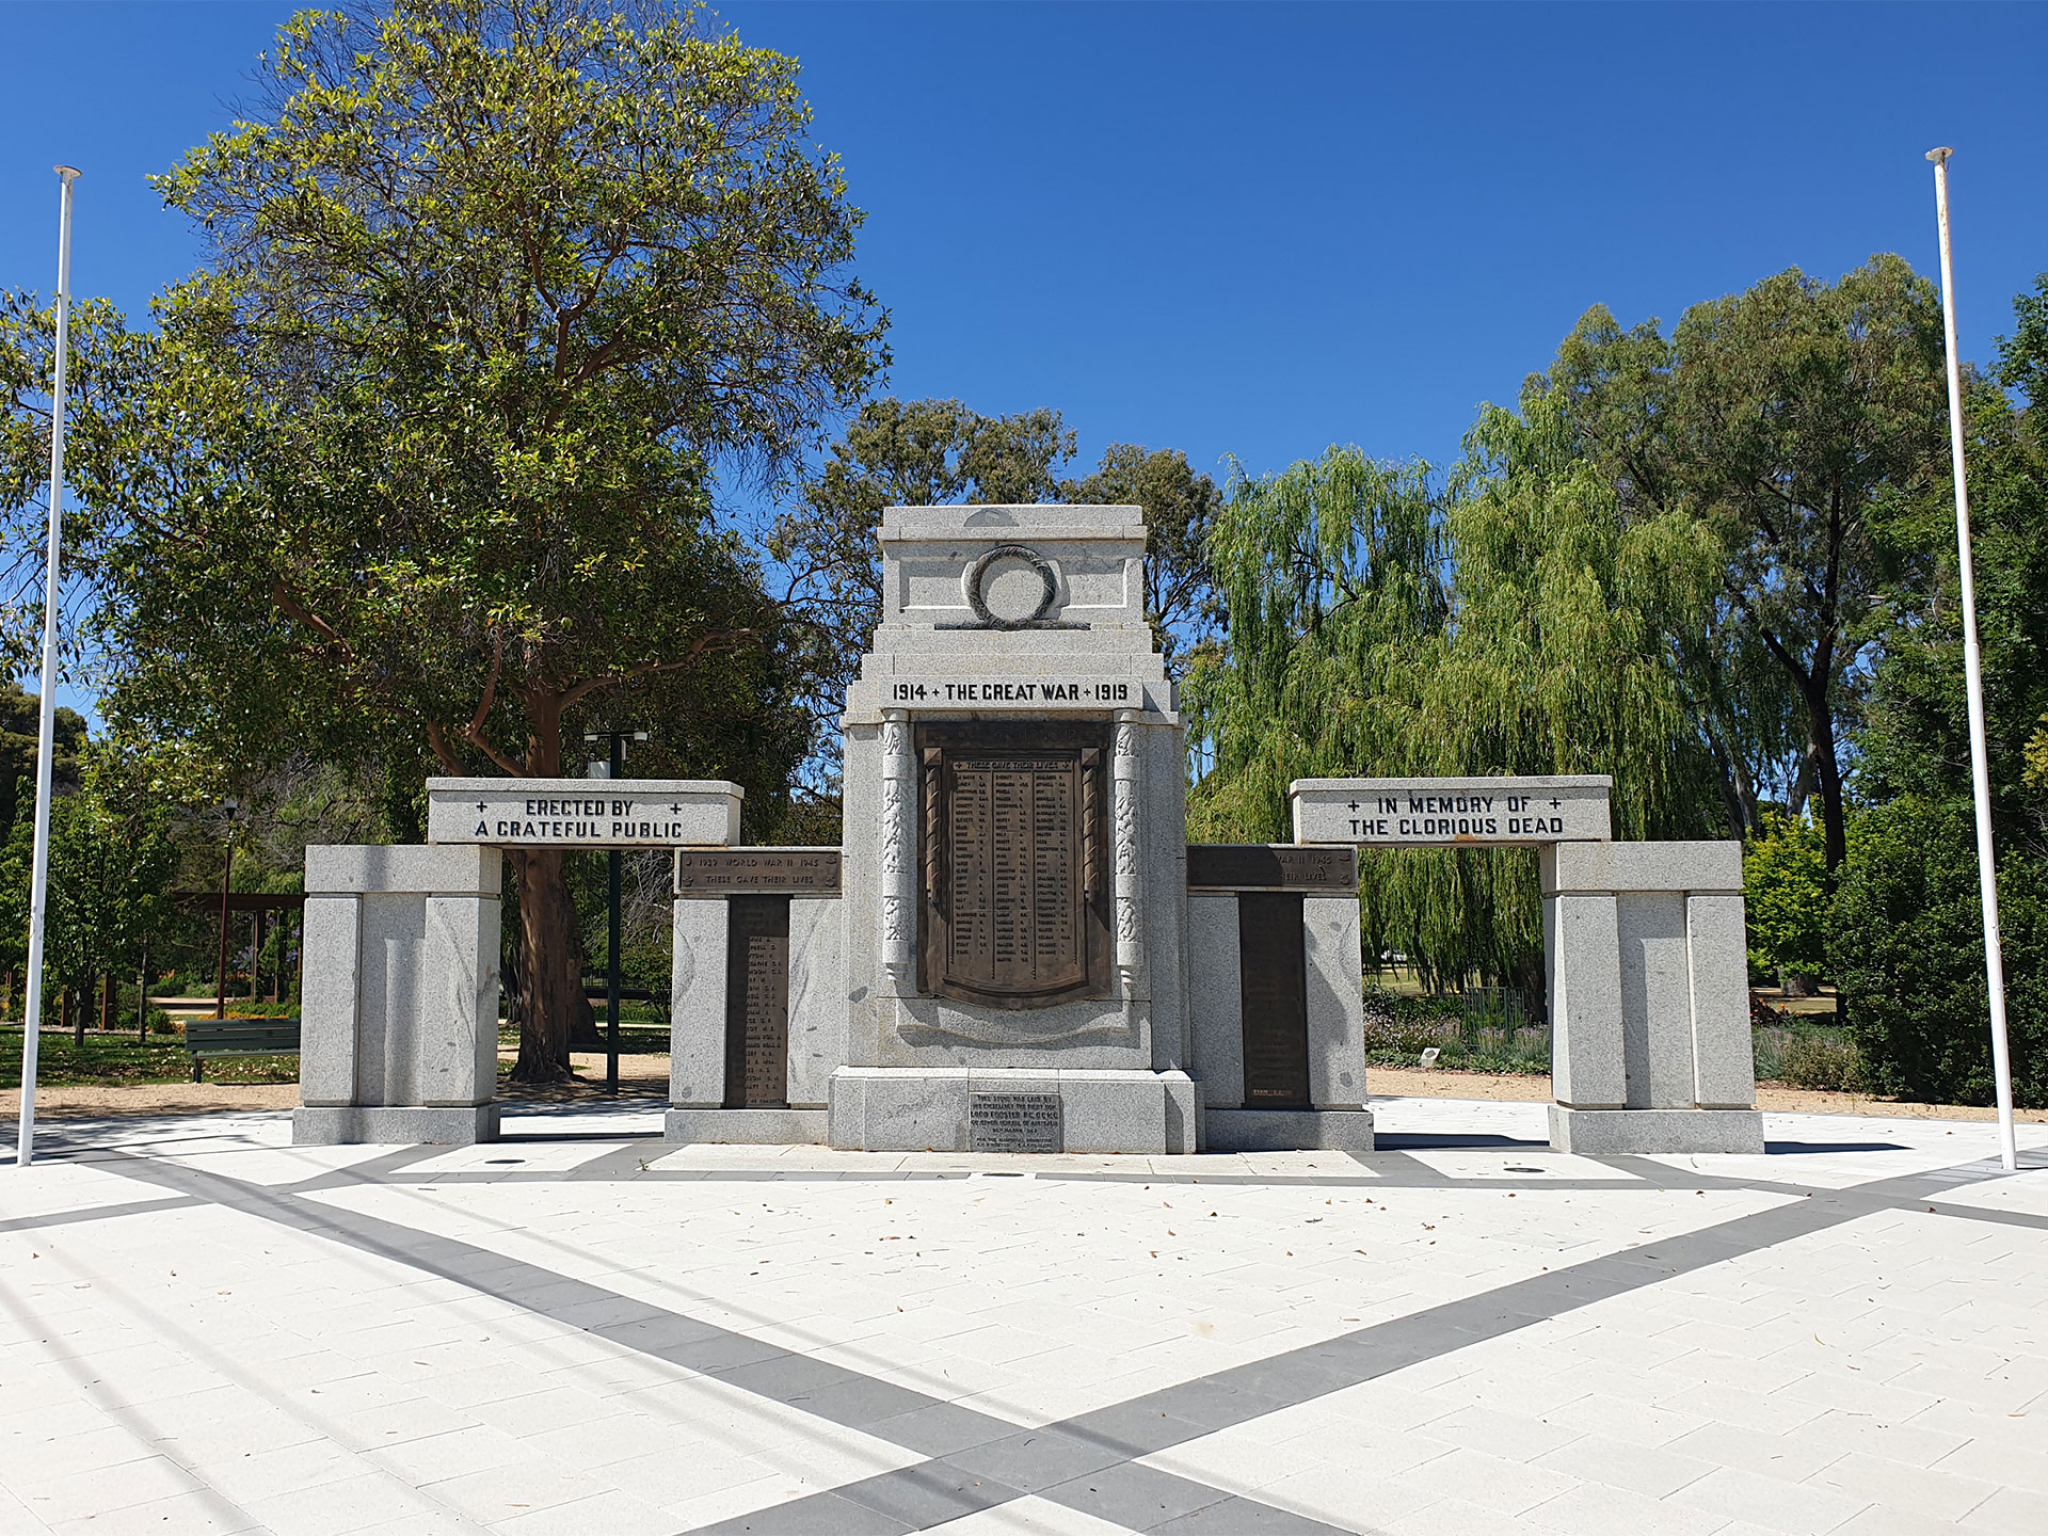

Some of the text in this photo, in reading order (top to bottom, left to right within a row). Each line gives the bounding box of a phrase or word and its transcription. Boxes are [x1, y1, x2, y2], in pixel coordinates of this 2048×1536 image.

[893, 684, 1128, 700] 1914 THE GREAT WAR 1919
[526, 799, 634, 816] ERECTED BY
[1378, 797, 1531, 814] IN MEMORY OF
[475, 821, 683, 837] A GRATEFUL PUBLIC
[1349, 818, 1389, 835] THE
[1509, 818, 1563, 835] DEAD
[700, 859, 718, 867] 1939
[725, 859, 758, 867] WORLD
[765, 859, 782, 867] WAR
[800, 859, 819, 867] 1945
[705, 876, 815, 884] THESE GAVE THEIR LIVES
